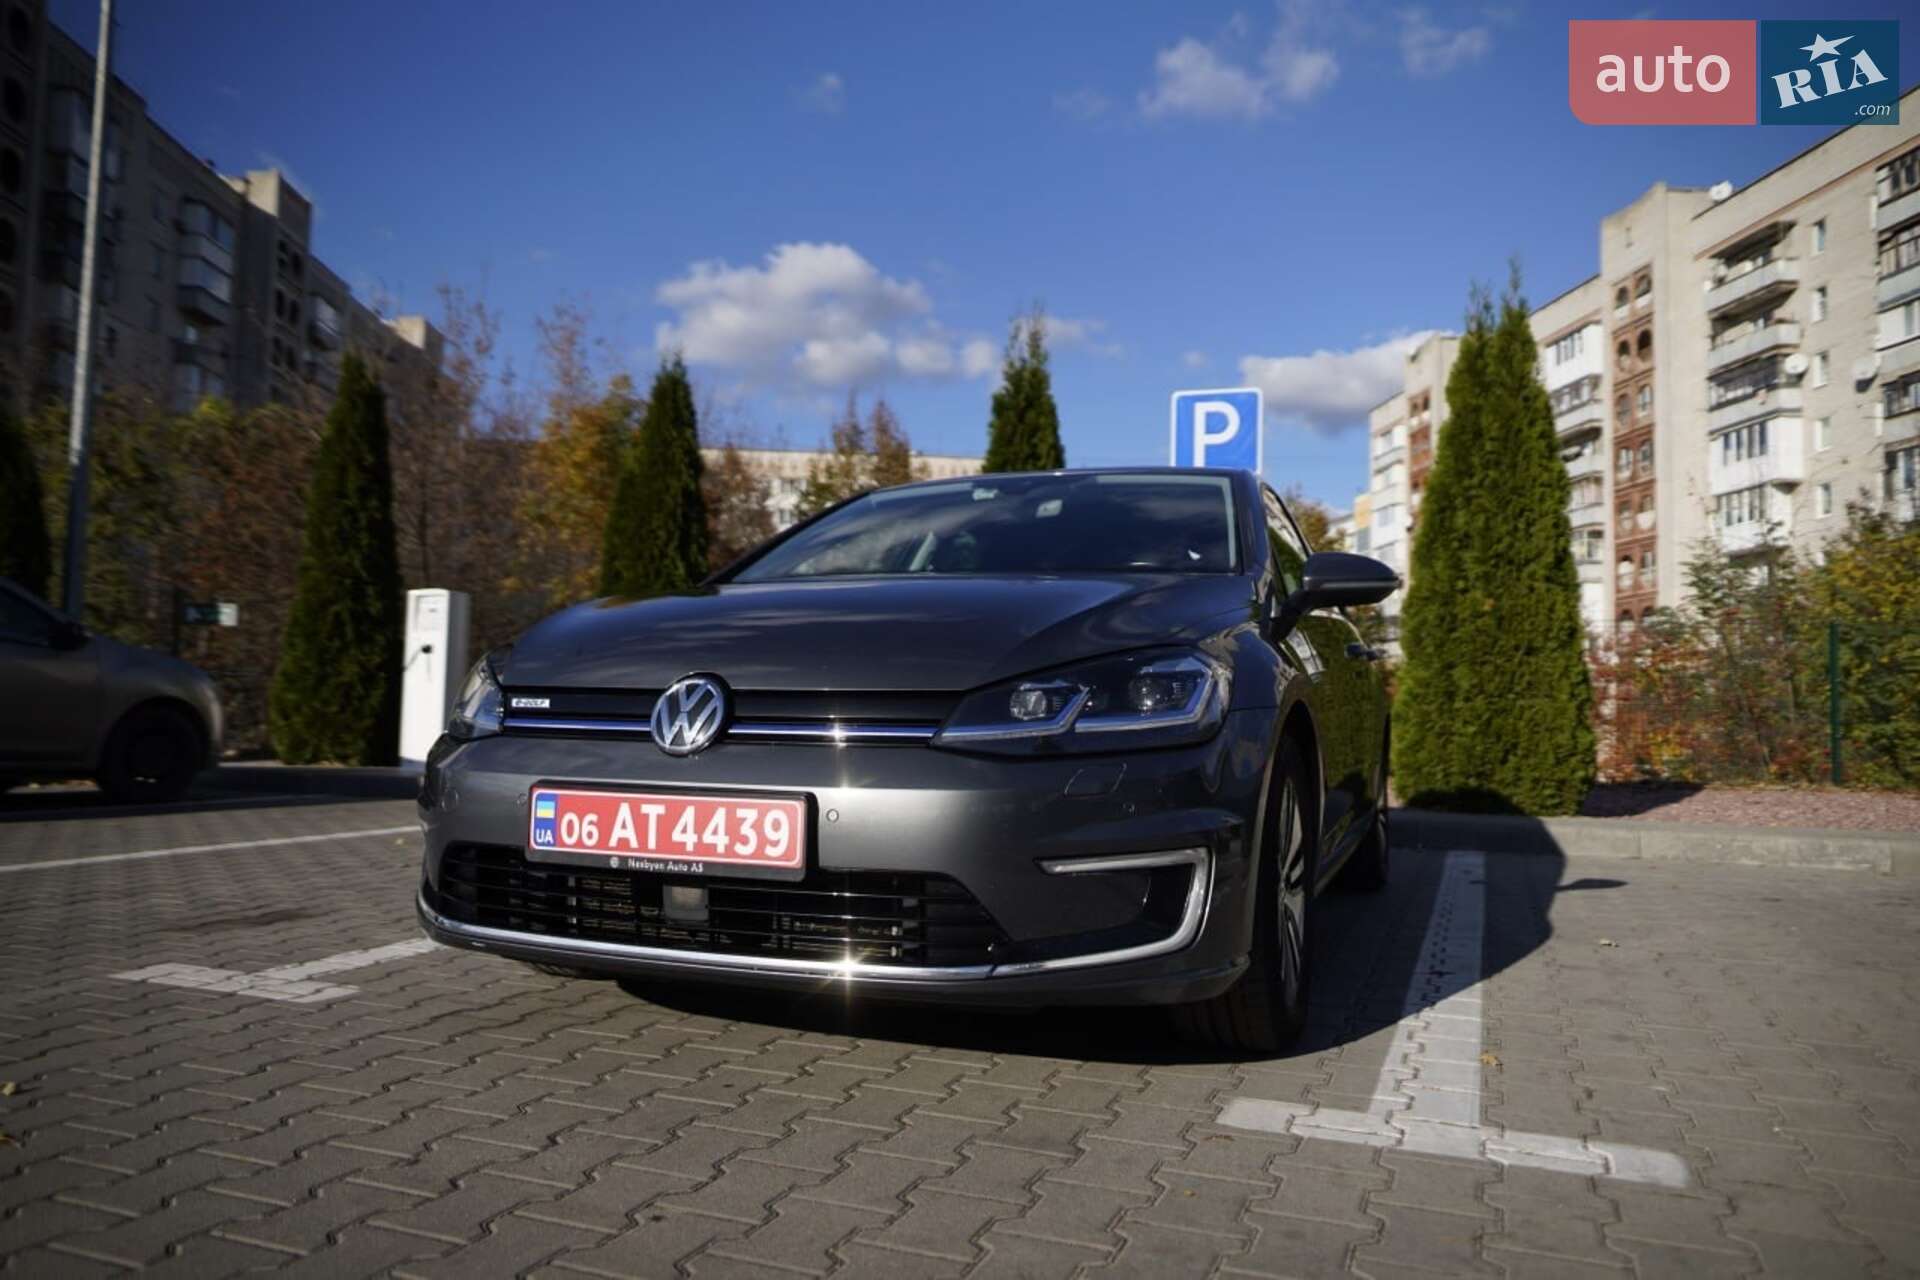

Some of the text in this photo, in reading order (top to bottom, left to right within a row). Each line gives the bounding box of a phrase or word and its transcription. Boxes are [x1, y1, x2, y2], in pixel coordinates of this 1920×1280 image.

[1193, 401, 1240, 467] P
[536, 829, 554, 844] UA
[560, 812, 599, 846] 06
[667, 861, 688, 871] Auto
